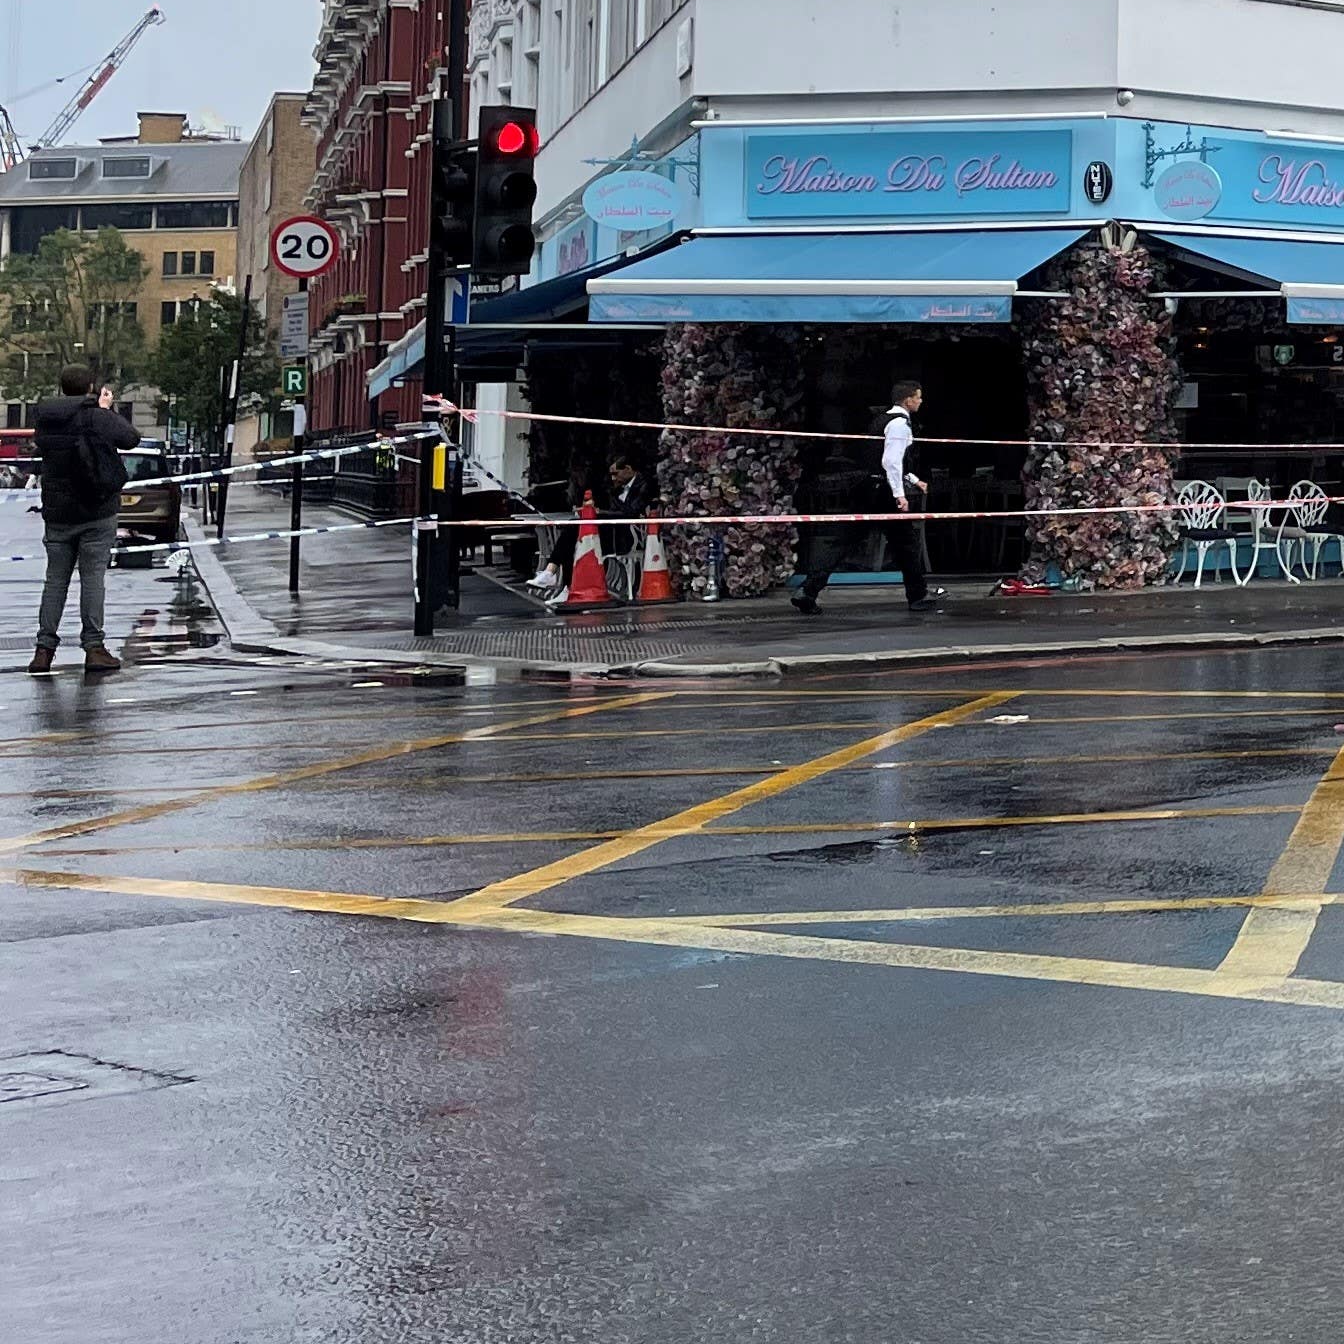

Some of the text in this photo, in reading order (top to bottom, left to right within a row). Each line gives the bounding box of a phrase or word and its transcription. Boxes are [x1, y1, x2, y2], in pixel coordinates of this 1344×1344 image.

[757, 151, 1059, 199] Maison Du Sultan
[281, 234, 330, 260] 20
[287, 370, 303, 391] R
